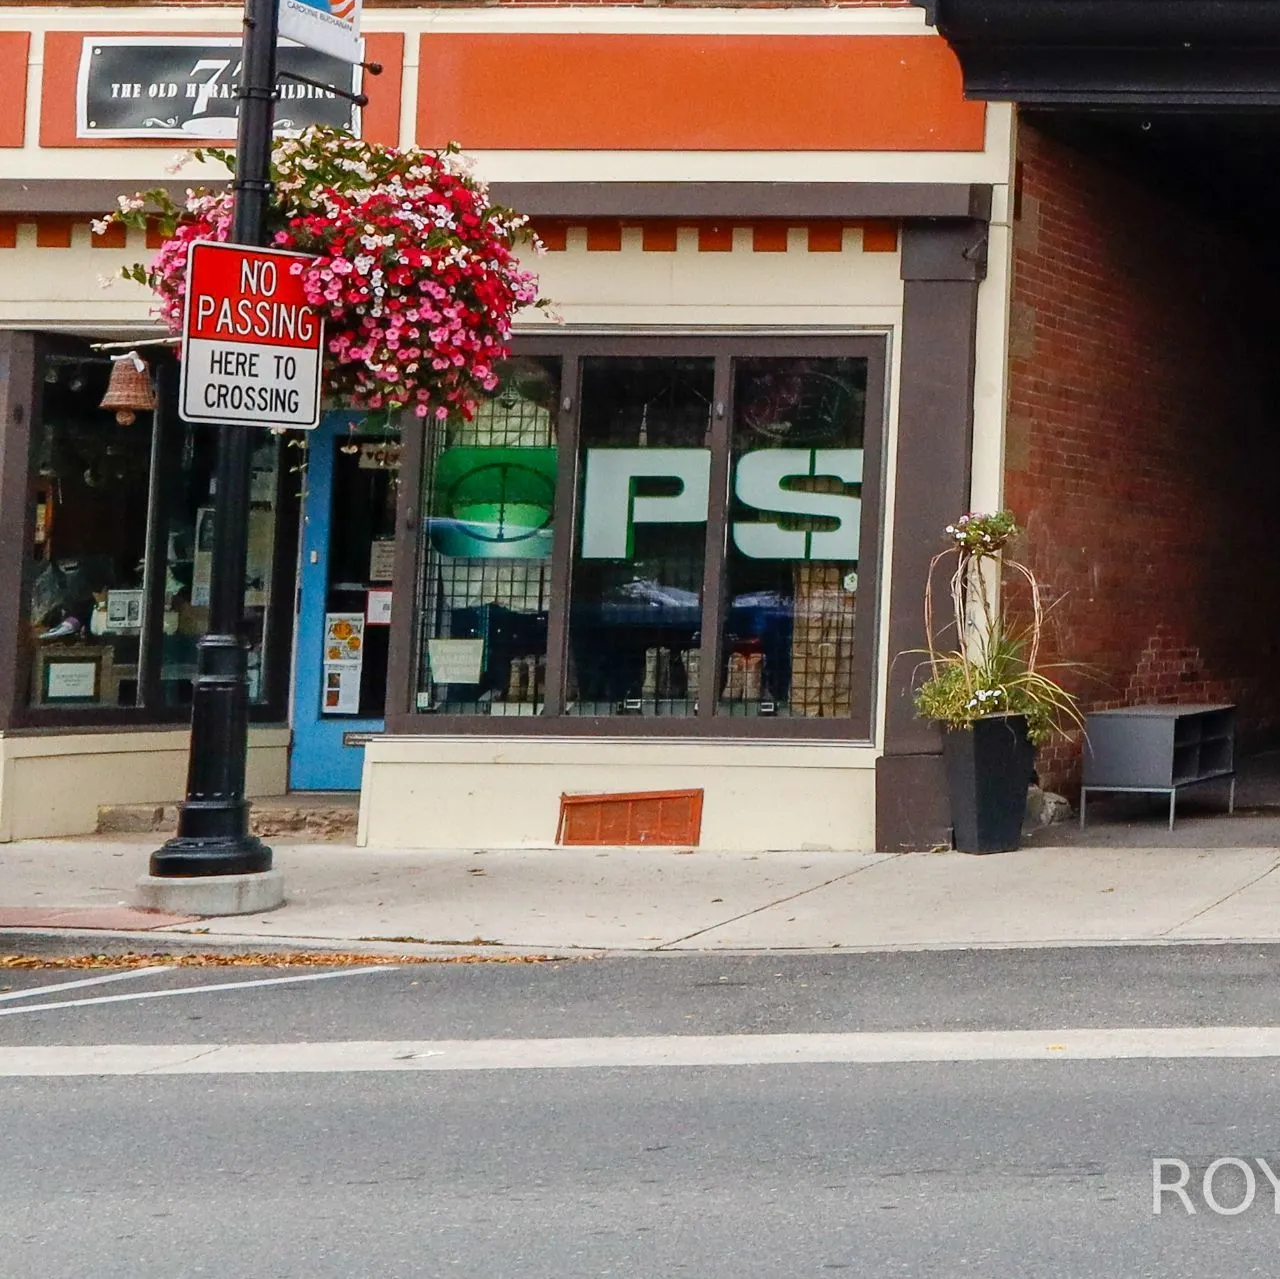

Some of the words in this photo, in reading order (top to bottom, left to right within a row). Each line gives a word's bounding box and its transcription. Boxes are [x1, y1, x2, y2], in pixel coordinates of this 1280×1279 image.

[111, 83, 141, 98] THE
[148, 83, 178, 98] OLD
[240, 258, 277, 297] NO
[197, 294, 313, 341] PASSING
[210, 349, 260, 378] HERE
[274, 355, 296, 381] TO
[204, 383, 299, 414] CROSSING
